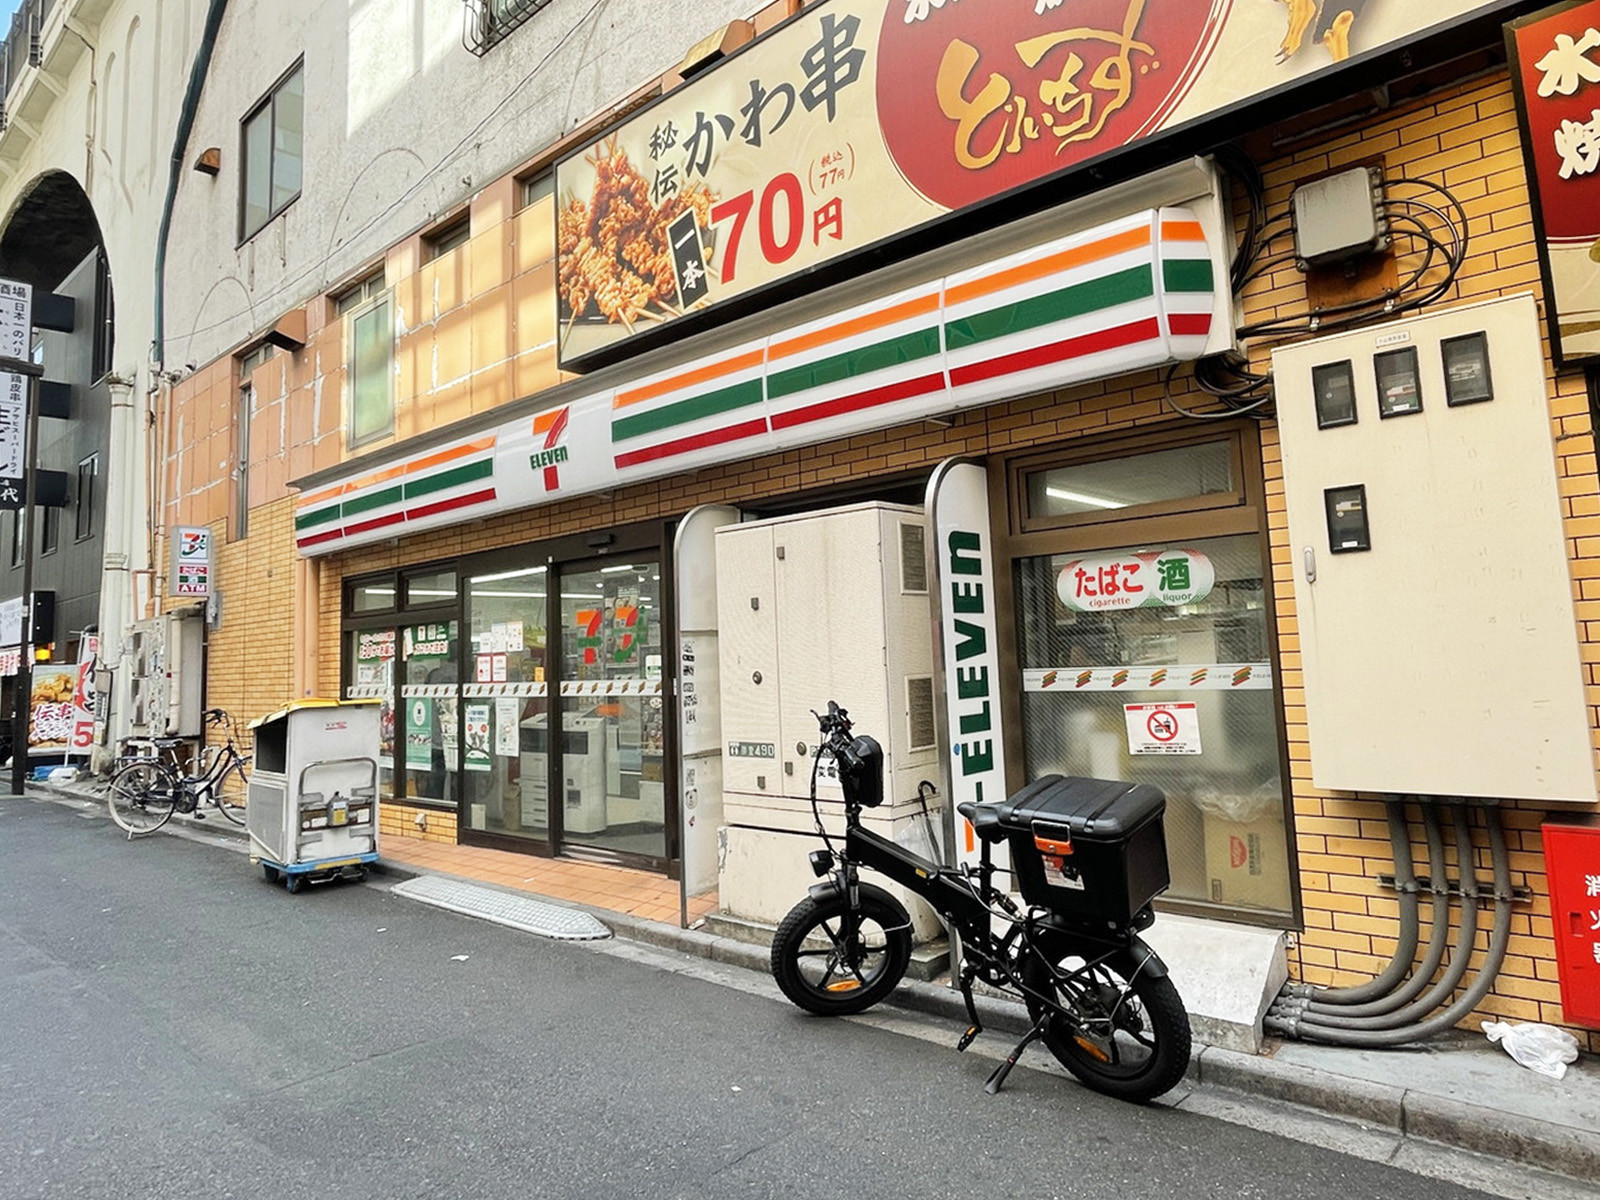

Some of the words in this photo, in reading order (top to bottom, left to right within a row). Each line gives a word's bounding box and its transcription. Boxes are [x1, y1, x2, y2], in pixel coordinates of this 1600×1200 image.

[682, 13, 867, 177] かわ串
[649, 121, 679, 205] 秘伝
[675, 228, 705, 291] 一本
[532, 406, 570, 491] 7
[180, 584, 206, 593] ATM
[1074, 562, 1144, 598] たばこ
[1156, 557, 1191, 592] 酒
[1088, 596, 1131, 608] cigarette
[1162, 592, 1193, 604] liquor
